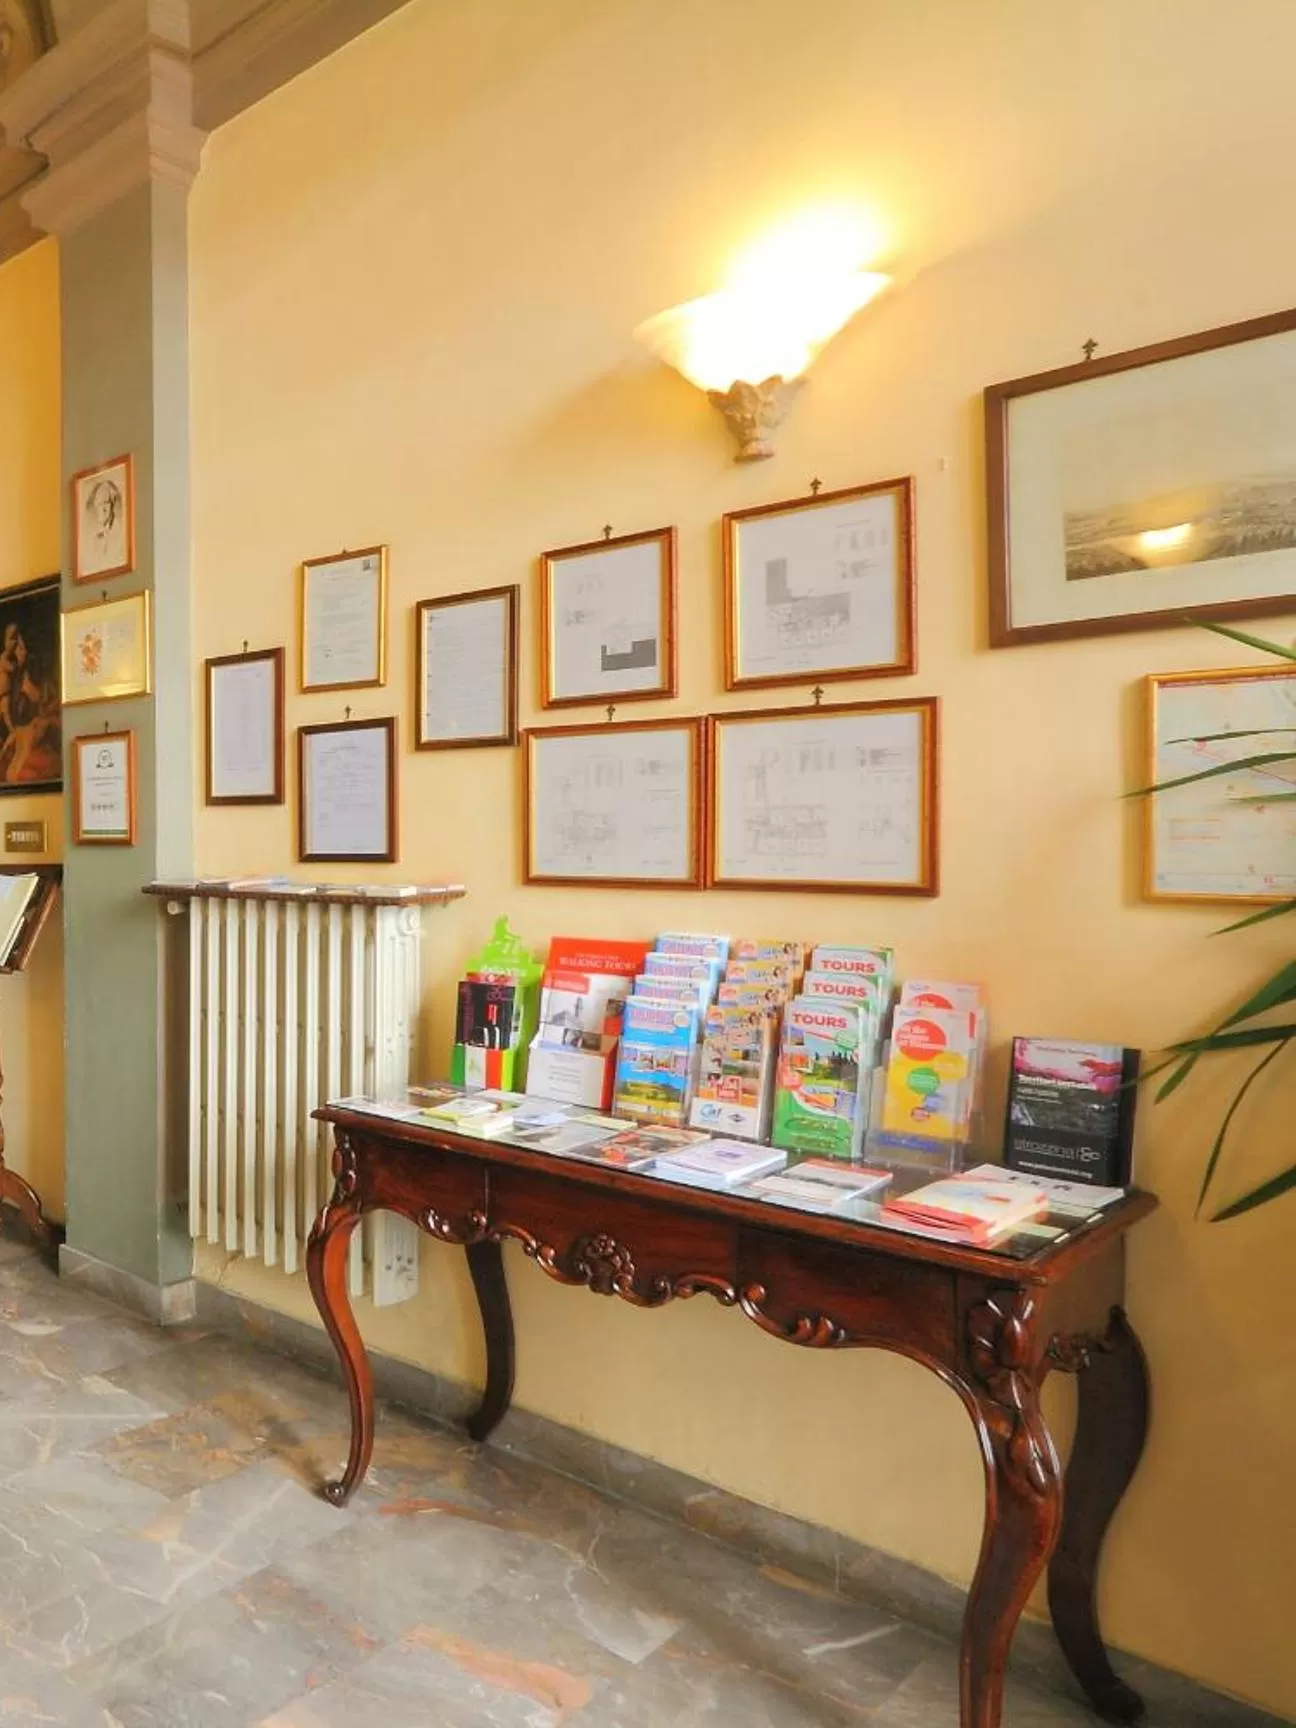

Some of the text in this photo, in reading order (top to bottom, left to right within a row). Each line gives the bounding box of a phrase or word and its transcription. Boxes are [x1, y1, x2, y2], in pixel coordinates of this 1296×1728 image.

[821, 959, 876, 974] TOURS
[812, 981, 868, 998] TOURS
[791, 1012, 848, 1029] TOURS
